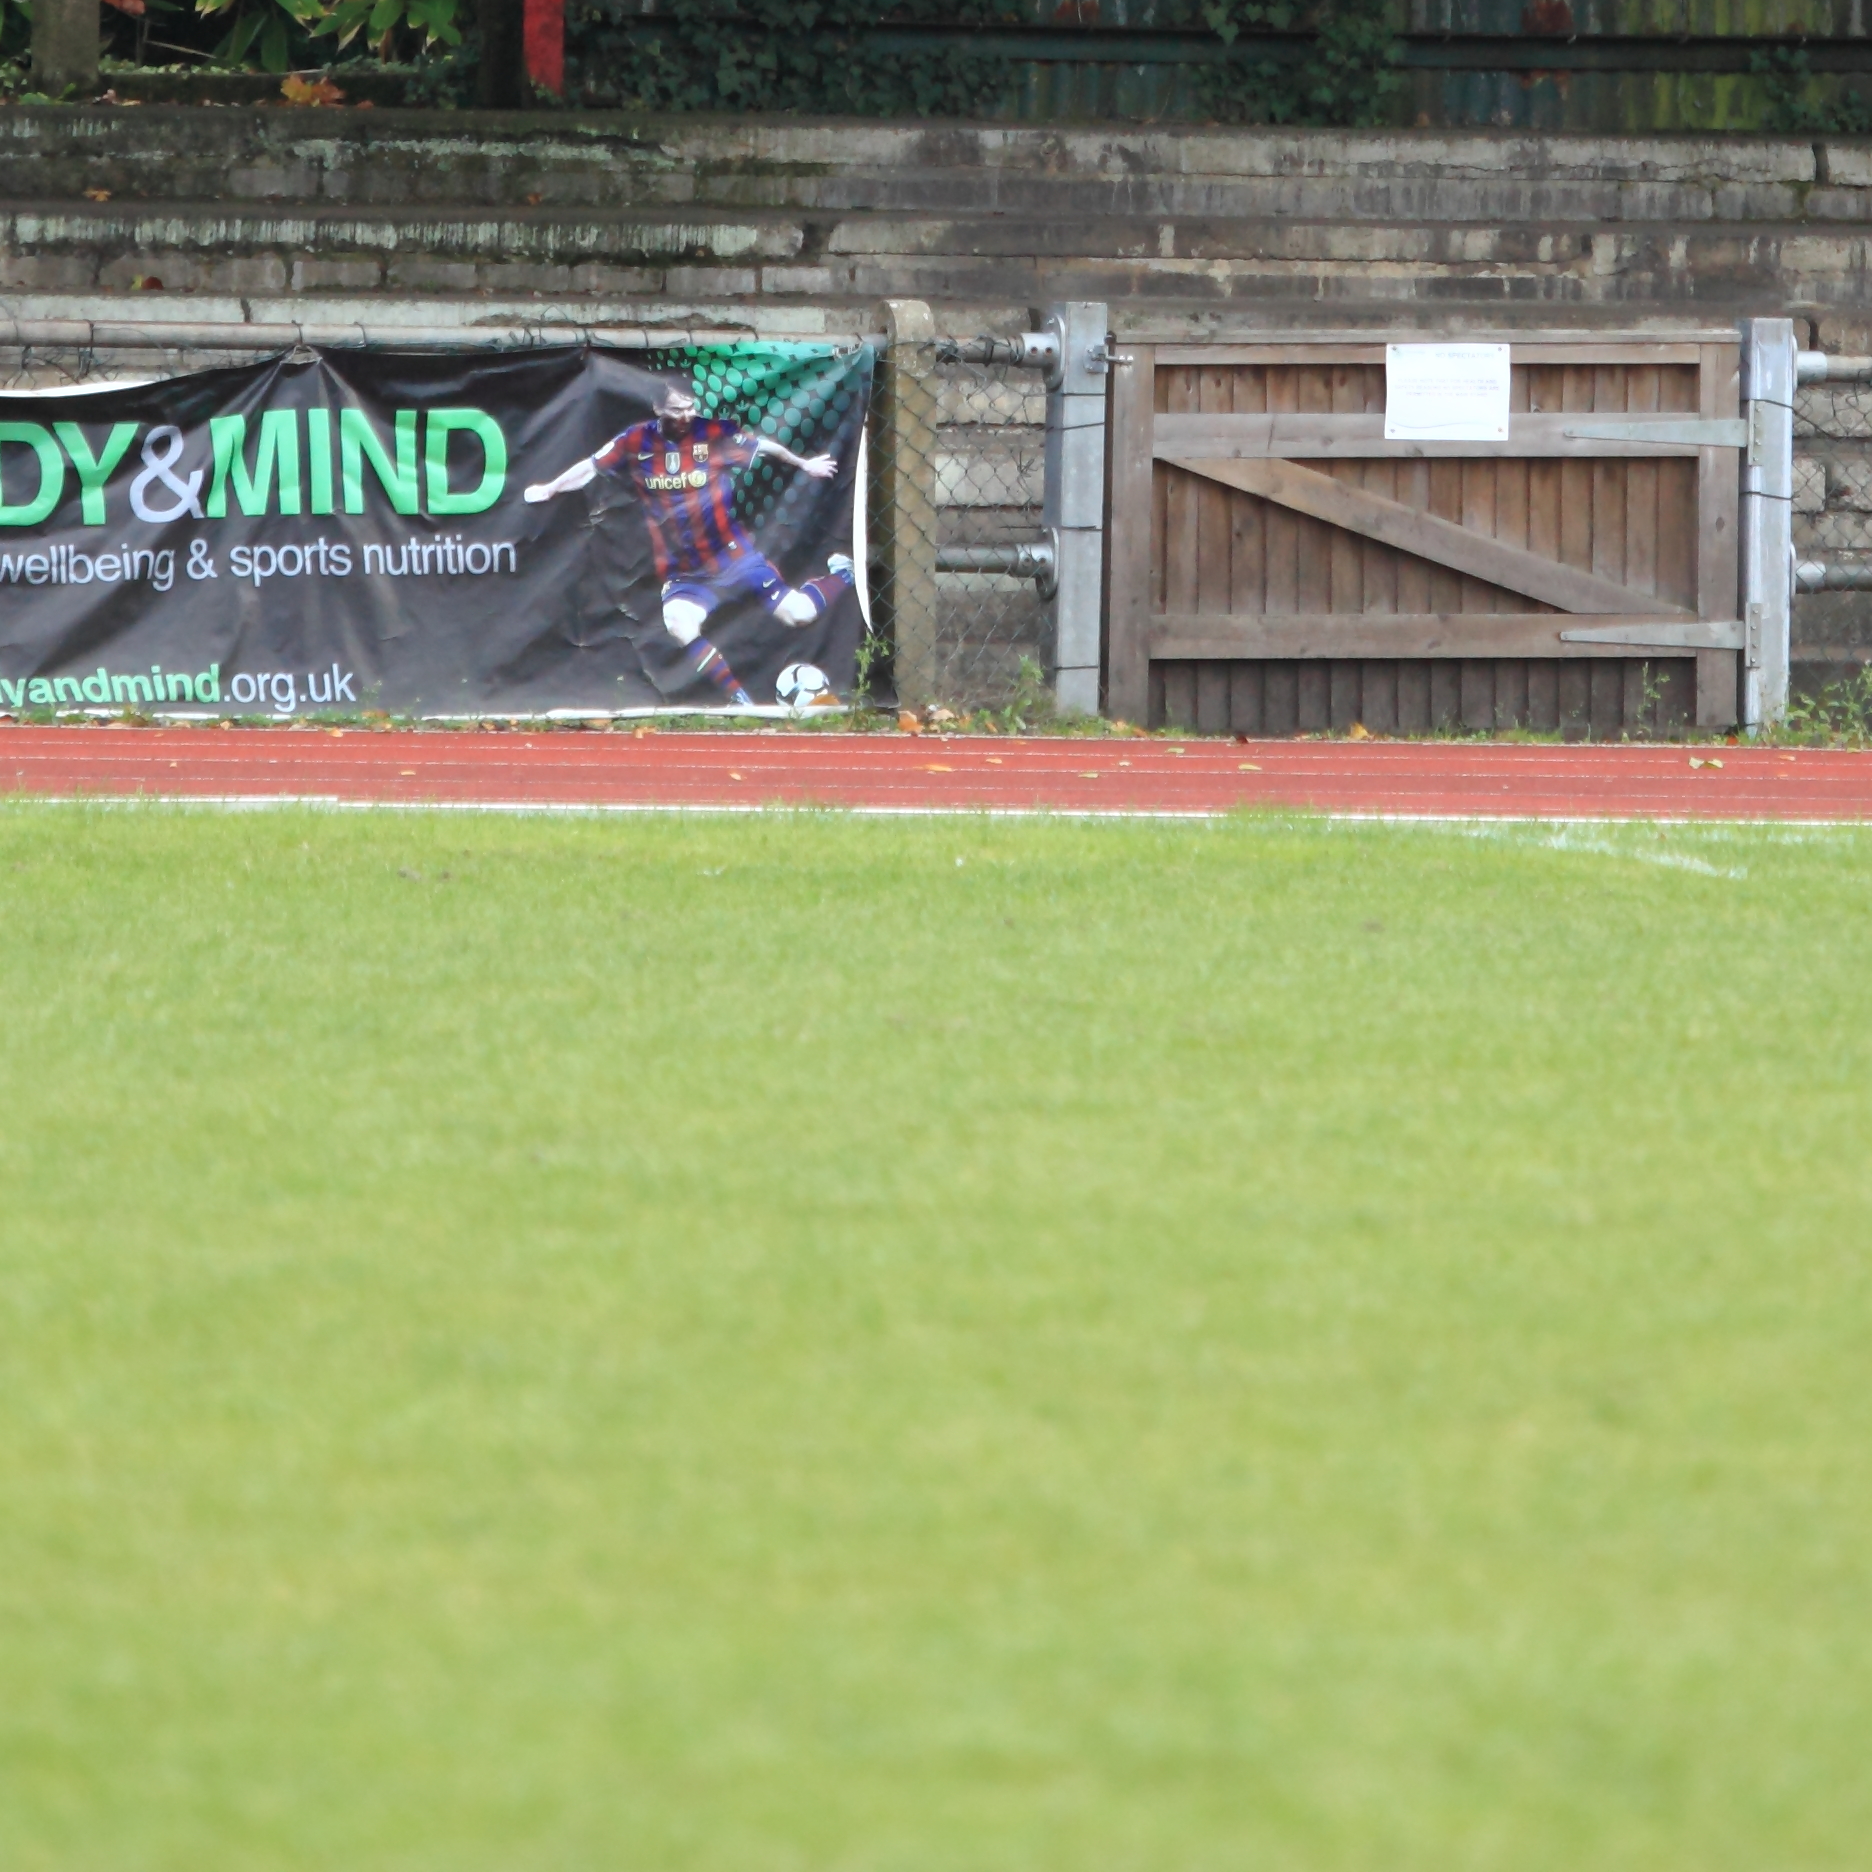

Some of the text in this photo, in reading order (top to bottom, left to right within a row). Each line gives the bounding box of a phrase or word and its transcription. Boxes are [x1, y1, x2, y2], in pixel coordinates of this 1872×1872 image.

[644, 474, 688, 490] unicef
[185, 536, 219, 580] &
[228, 535, 354, 587] sports
[362, 532, 517, 576] nutrition
